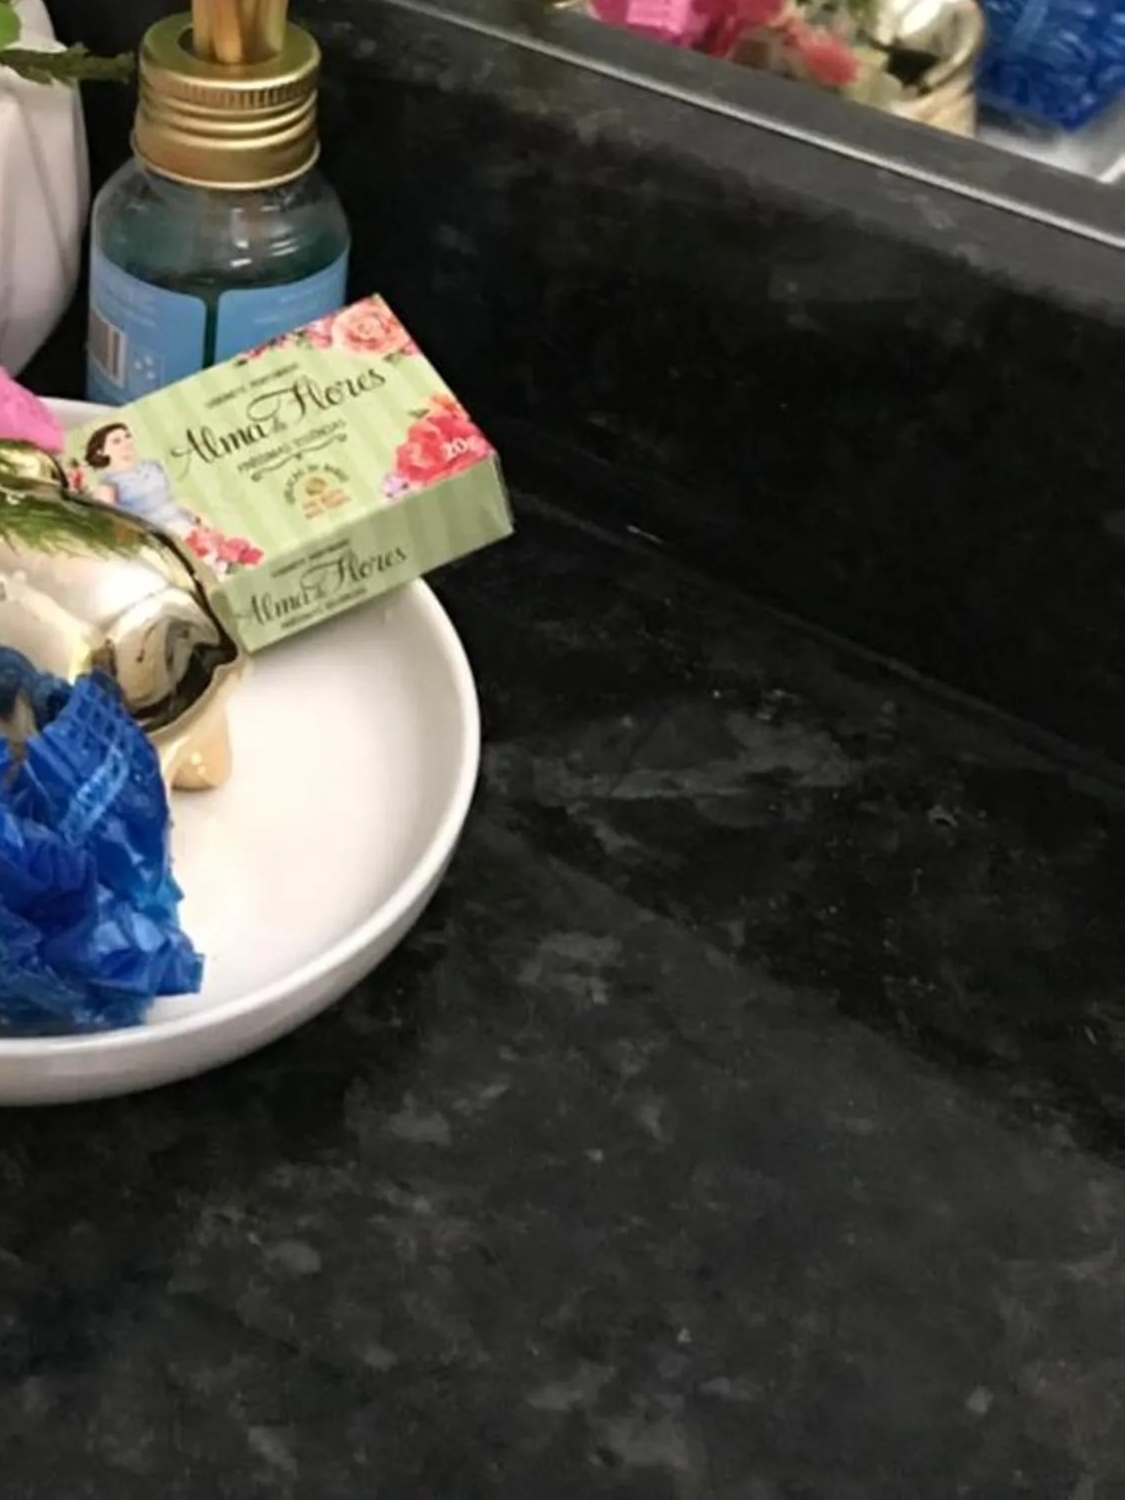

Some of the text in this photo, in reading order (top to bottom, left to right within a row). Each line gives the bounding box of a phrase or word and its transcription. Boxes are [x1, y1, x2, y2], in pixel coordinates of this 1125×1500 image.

[171, 421, 269, 482] Alma
[246, 366, 387, 426] Flores
[233, 588, 312, 626] Alma
[299, 546, 409, 599] Flores
